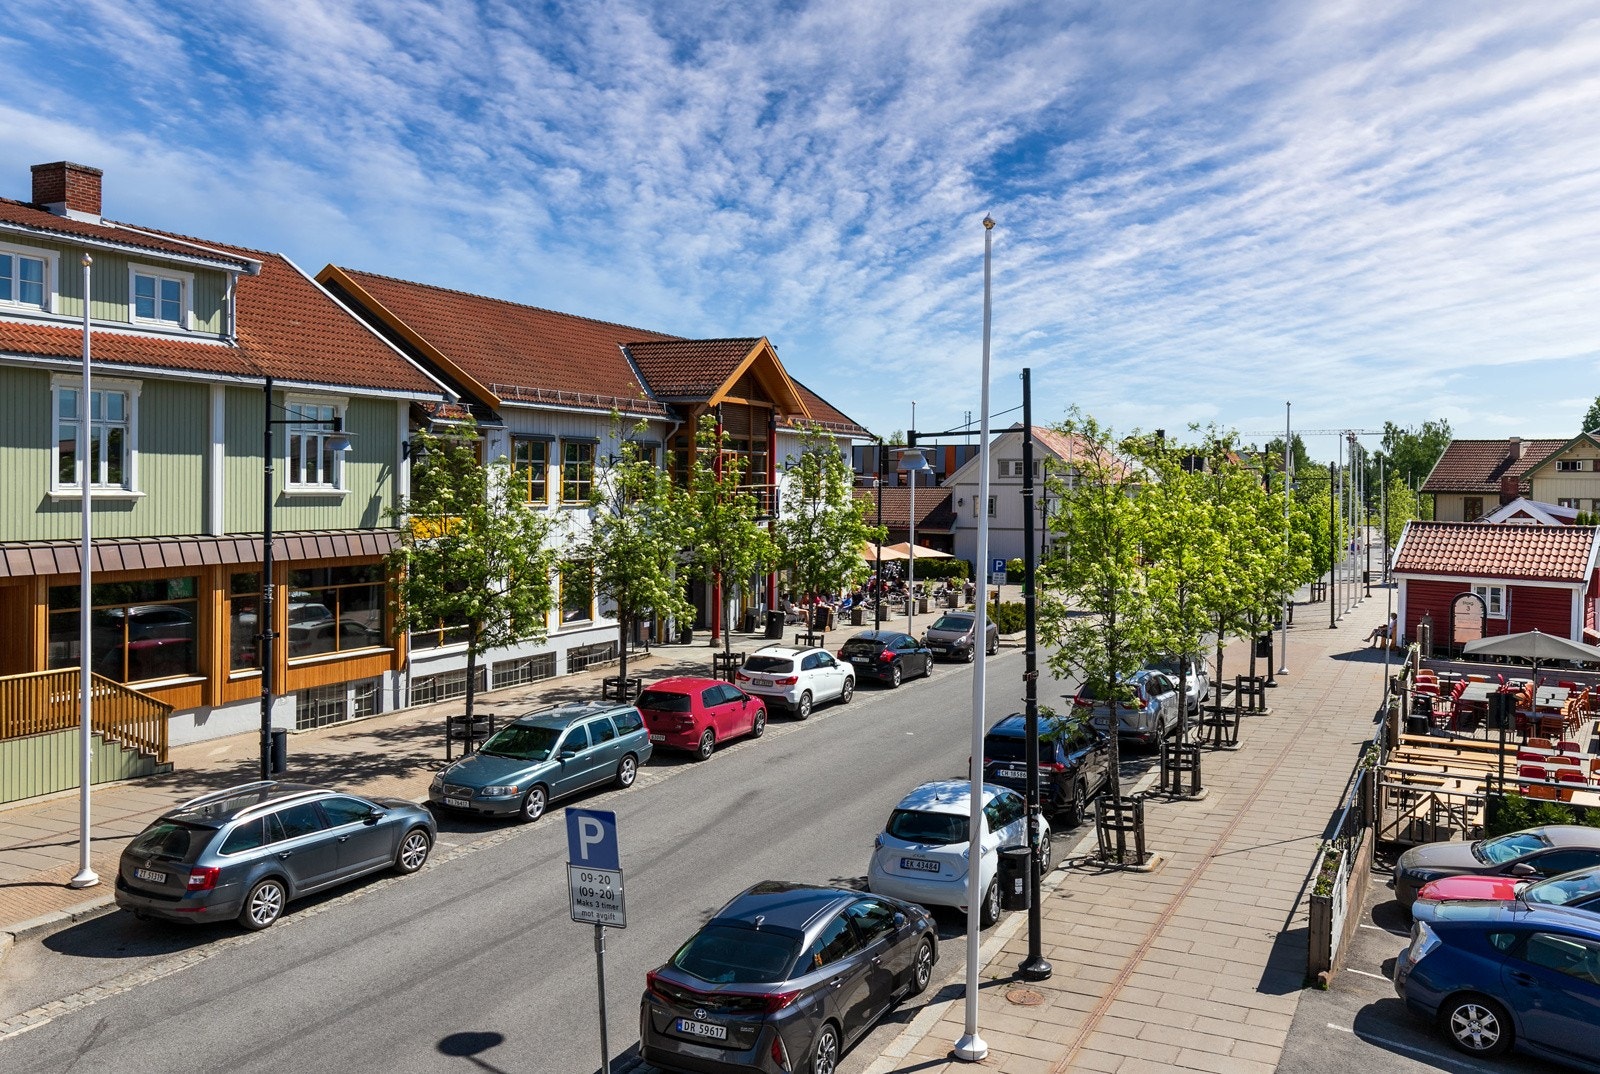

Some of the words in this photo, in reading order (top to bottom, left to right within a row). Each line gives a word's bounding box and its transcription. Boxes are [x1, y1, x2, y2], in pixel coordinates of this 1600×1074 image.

[996, 561, 1003, 571] P
[577, 816, 605, 860] P
[916, 862, 938, 870] 43484
[139, 870, 147, 878] ZT
[148, 872, 164, 880] 51319
[580, 872, 611, 885] 09-20
[579, 885, 615, 901] (09-20)
[576, 898, 593, 908] Maks
[596, 900, 600, 908] 3
[601, 902, 619, 911] timer
[581, 910, 594, 918] mot
[596, 911, 616, 921] avgift
[684, 1021, 696, 1033] DR
[699, 1024, 724, 1037] 59617
